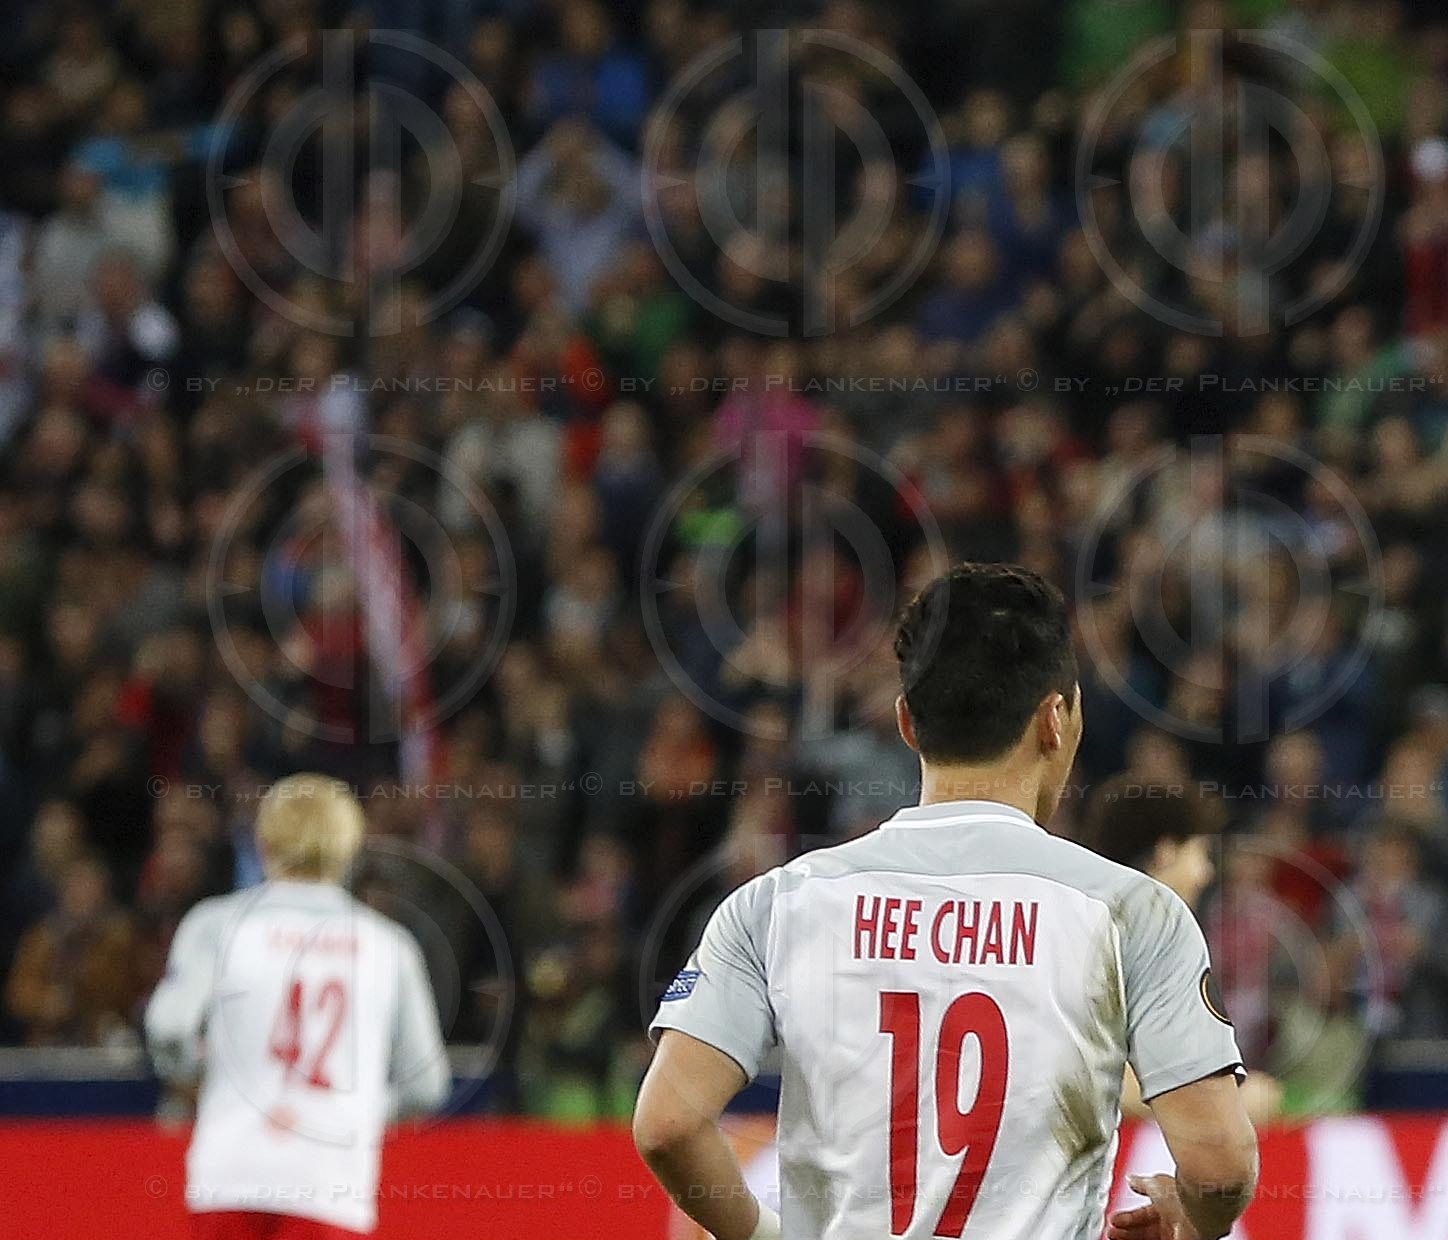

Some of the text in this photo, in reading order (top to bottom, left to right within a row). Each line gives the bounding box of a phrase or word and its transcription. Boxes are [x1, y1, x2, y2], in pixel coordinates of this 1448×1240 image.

[853, 894, 1039, 965] HEE CHAN
[265, 976, 351, 1091] 42
[879, 991, 1010, 1239] 19
